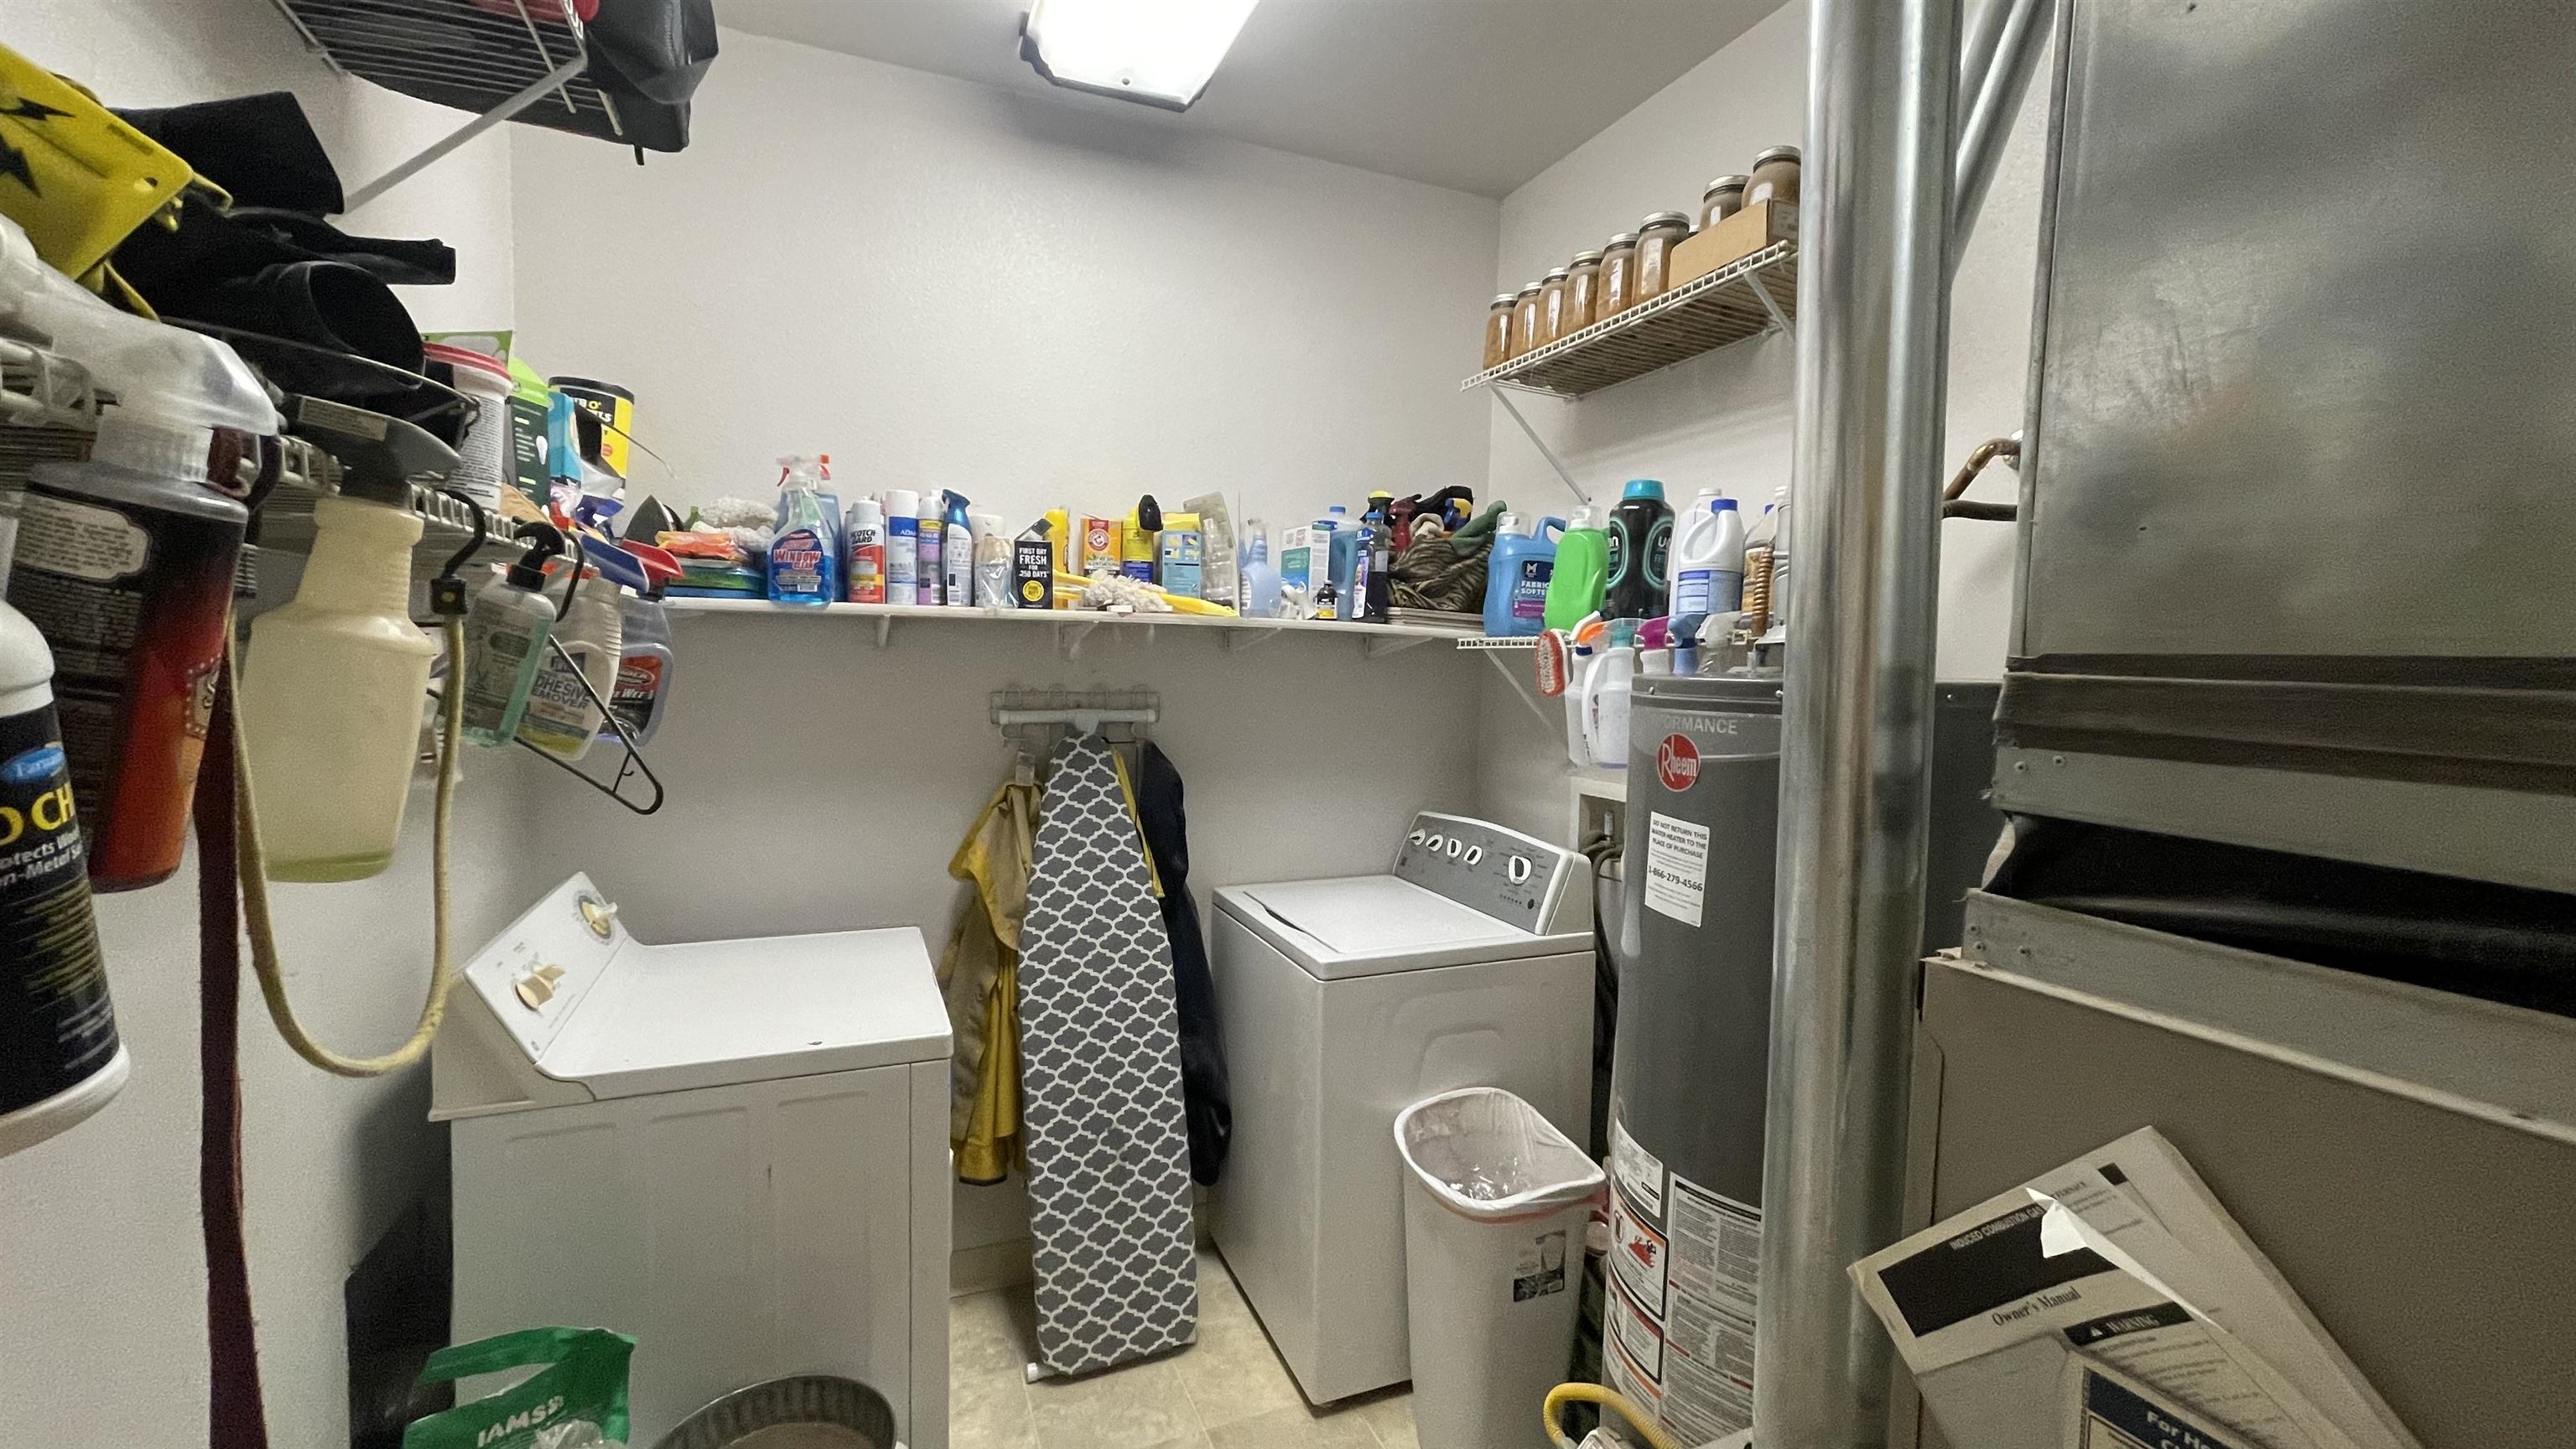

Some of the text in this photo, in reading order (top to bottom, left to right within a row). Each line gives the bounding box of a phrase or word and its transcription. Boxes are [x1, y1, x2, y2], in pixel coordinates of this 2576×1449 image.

[1019, 554, 1047, 565] FRESH
[1521, 580, 1550, 589] FABRIC
[1521, 588, 1545, 596] SOFTE
[531, 686, 589, 709] EMOVER
[536, 674, 591, 701] DHESIVE
[1661, 735, 1697, 782] Rheem
[1651, 828, 1666, 837] WATER
[1666, 834, 1685, 844] HEATER
[1696, 842, 1706, 850] THE
[1660, 821, 1670, 830] NOT
[1670, 825, 1693, 837] RETURN
[1694, 831, 1707, 840] THIS
[1652, 838, 1665, 847] PLACE
[1674, 845, 1703, 859] PURCHASE
[1949, 1229, 1984, 1250] INDUCED
[1981, 1211, 2030, 1237] COMBUSTION
[2025, 1206, 2045, 1218] GAS
[1992, 1285, 2082, 1326] Owner's Manual
[2106, 1314, 2161, 1333] WARNING
[2147, 1410, 2179, 1437] For
